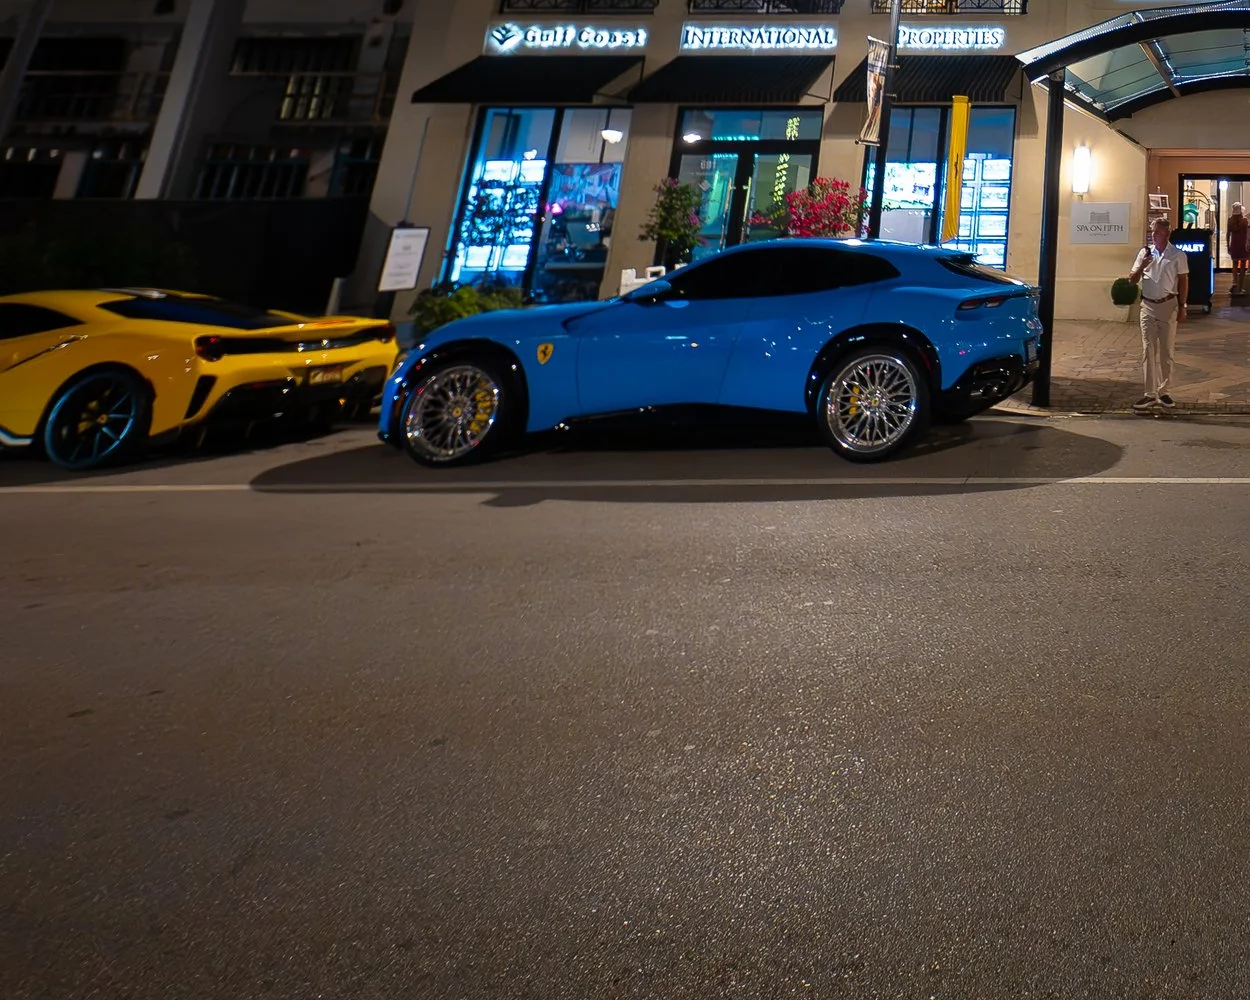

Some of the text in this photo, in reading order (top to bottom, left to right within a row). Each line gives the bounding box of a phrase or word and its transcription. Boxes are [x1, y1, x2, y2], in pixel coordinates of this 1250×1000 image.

[524, 25, 646, 47] Gulf Coast
[683, 26, 837, 48] INTERNATIONAL
[897, 26, 1003, 47] PROPERTIES
[1076, 224, 1089, 232] SPA
[1089, 224, 1102, 232] ON
